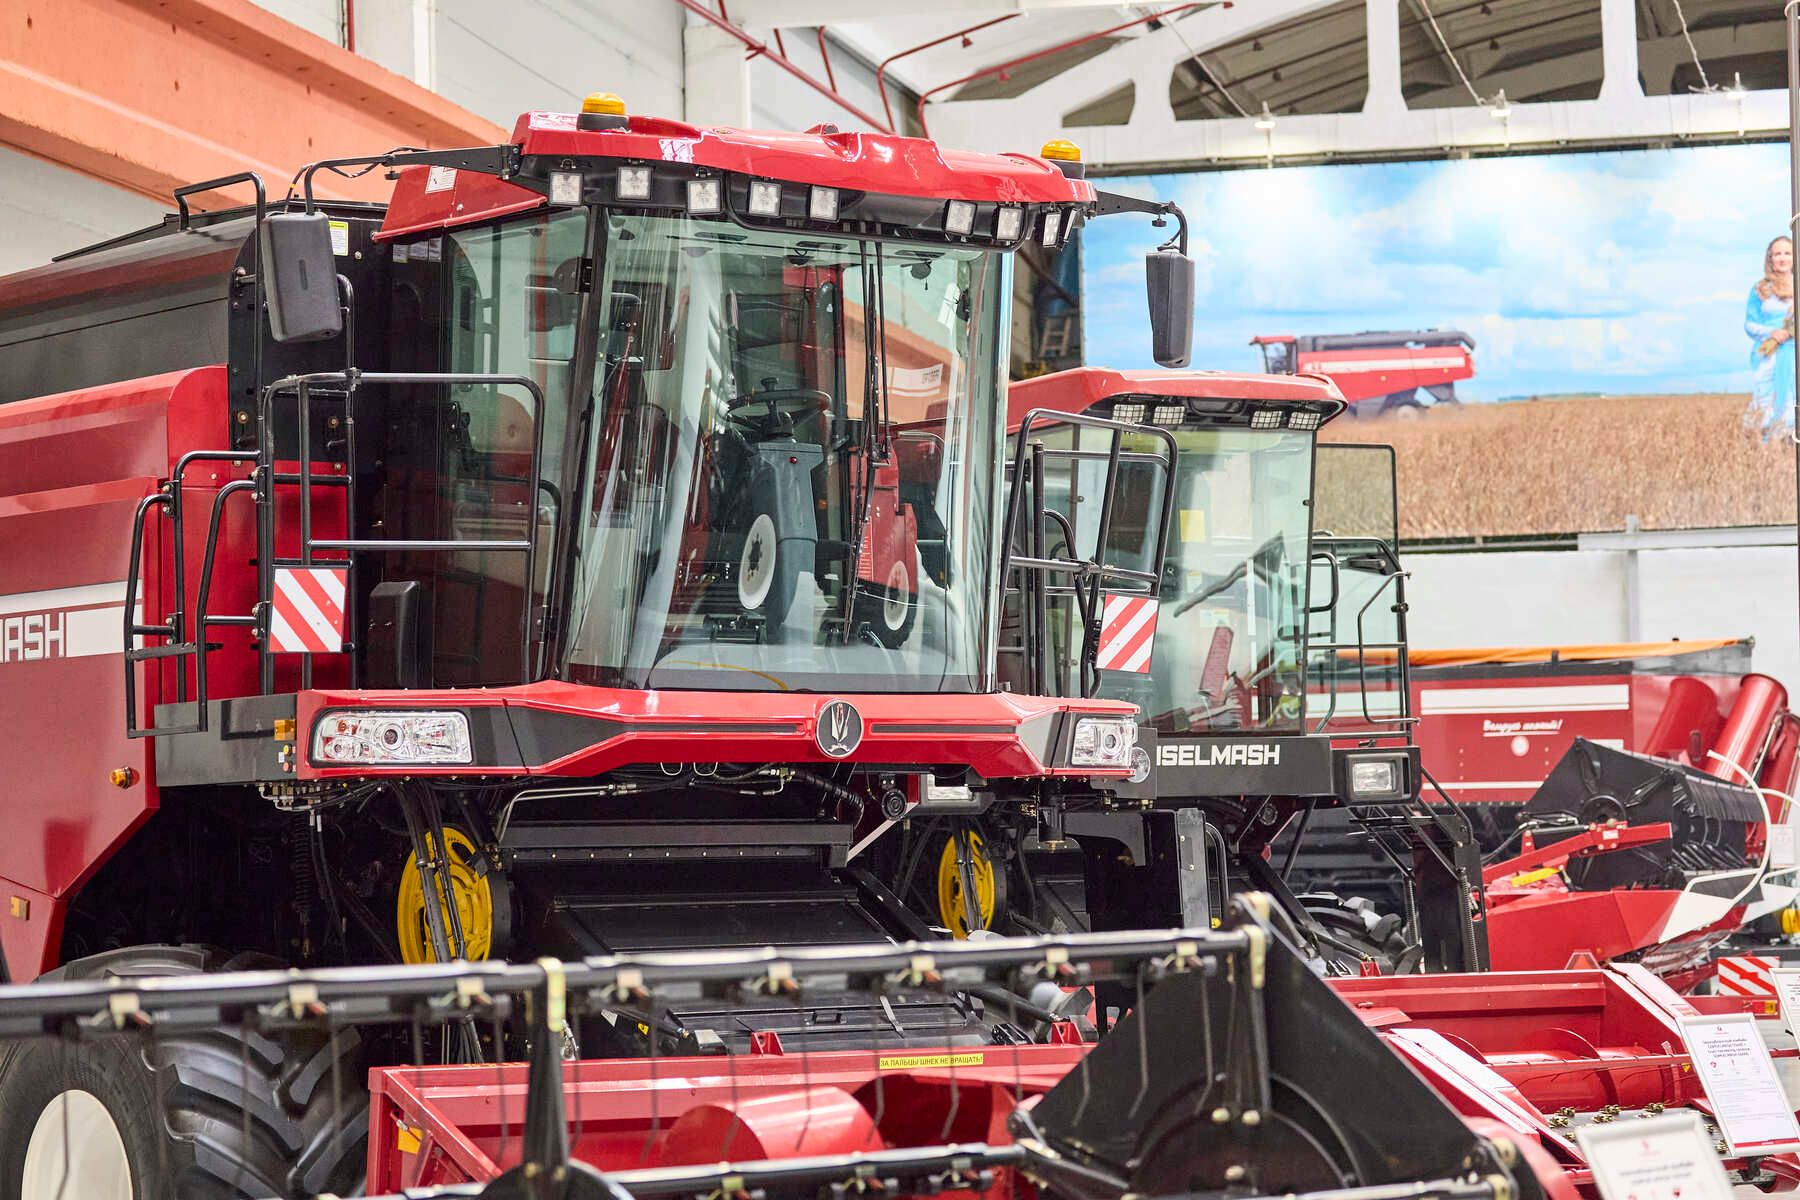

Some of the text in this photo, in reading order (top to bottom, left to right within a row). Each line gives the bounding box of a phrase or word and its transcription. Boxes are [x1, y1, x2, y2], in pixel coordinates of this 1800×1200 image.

[0, 611, 65, 663] ASH
[880, 1059, 889, 1067] ЗА
[890, 1058, 919, 1067] ПАЛЬЦЫ
[920, 1057, 939, 1066] ШНЕК
[940, 1057, 949, 1065] НЕ
